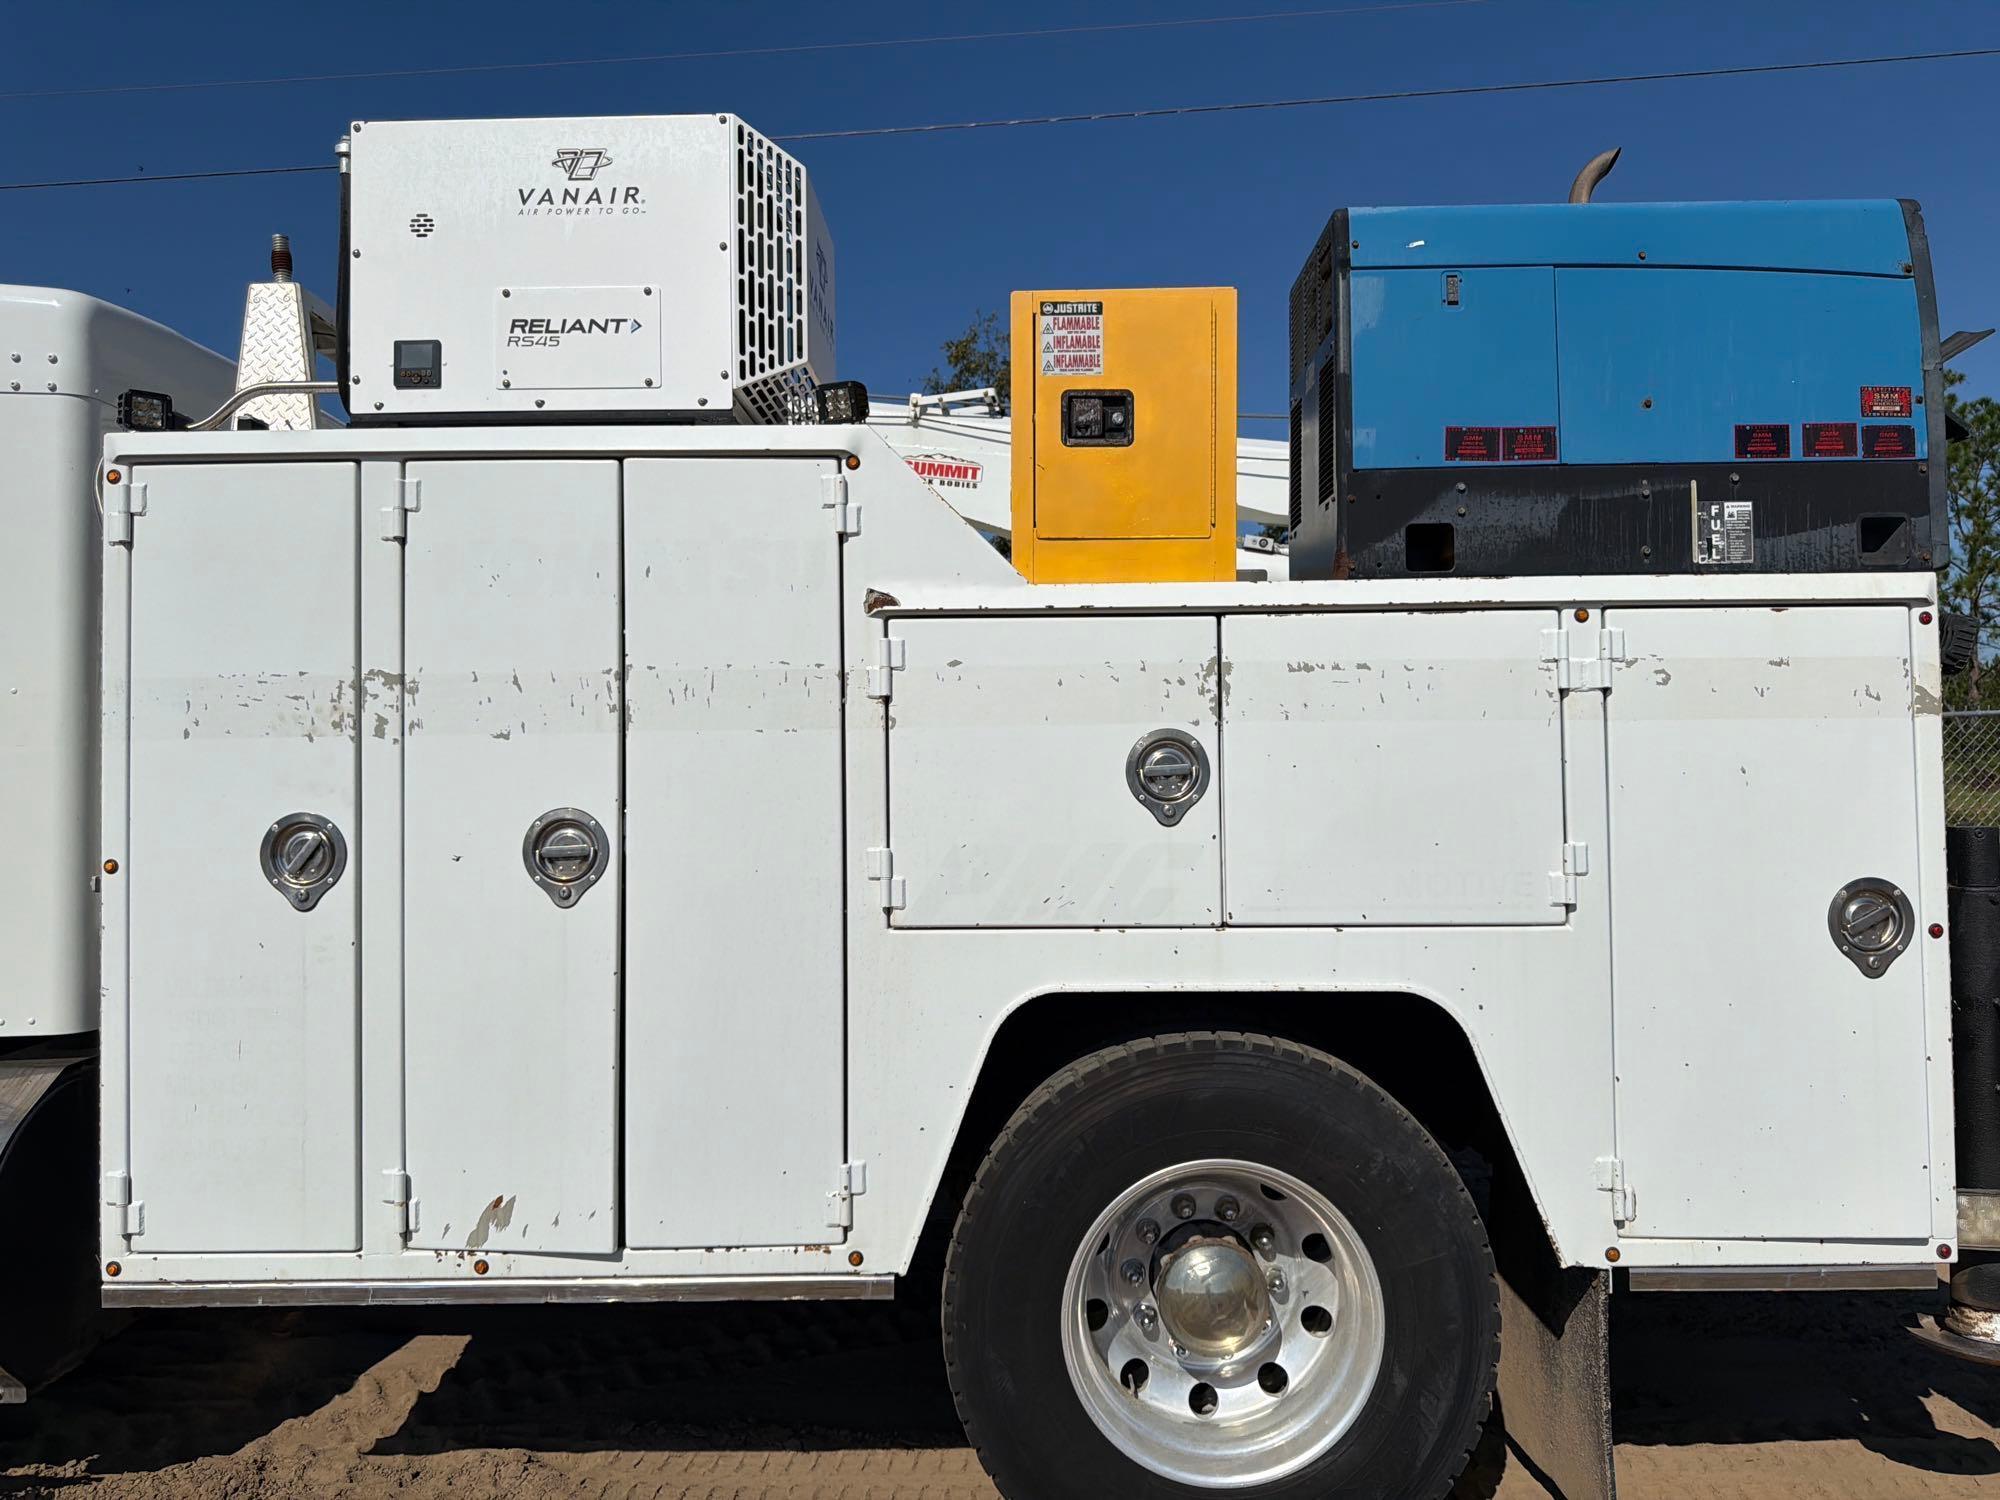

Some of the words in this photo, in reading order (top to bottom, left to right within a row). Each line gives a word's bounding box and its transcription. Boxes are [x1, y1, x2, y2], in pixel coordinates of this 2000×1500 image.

[517, 187, 641, 206] VANAIR
[518, 208, 539, 216] AIR
[547, 207, 590, 216] POWER
[600, 207, 614, 215] TO
[809, 271, 835, 344] VANAIR
[1054, 303, 1098, 313] JUSTRITE
[509, 318, 629, 334] RELIANT
[1053, 316, 1100, 330] FLAMMABLE
[507, 335, 561, 347] RS45
[1053, 335, 1101, 349] INFLAMABLE
[1053, 354, 1101, 368] INFLAMMABLE
[939, 480, 978, 489] BODIES
[1710, 505, 1721, 560] FUEL
